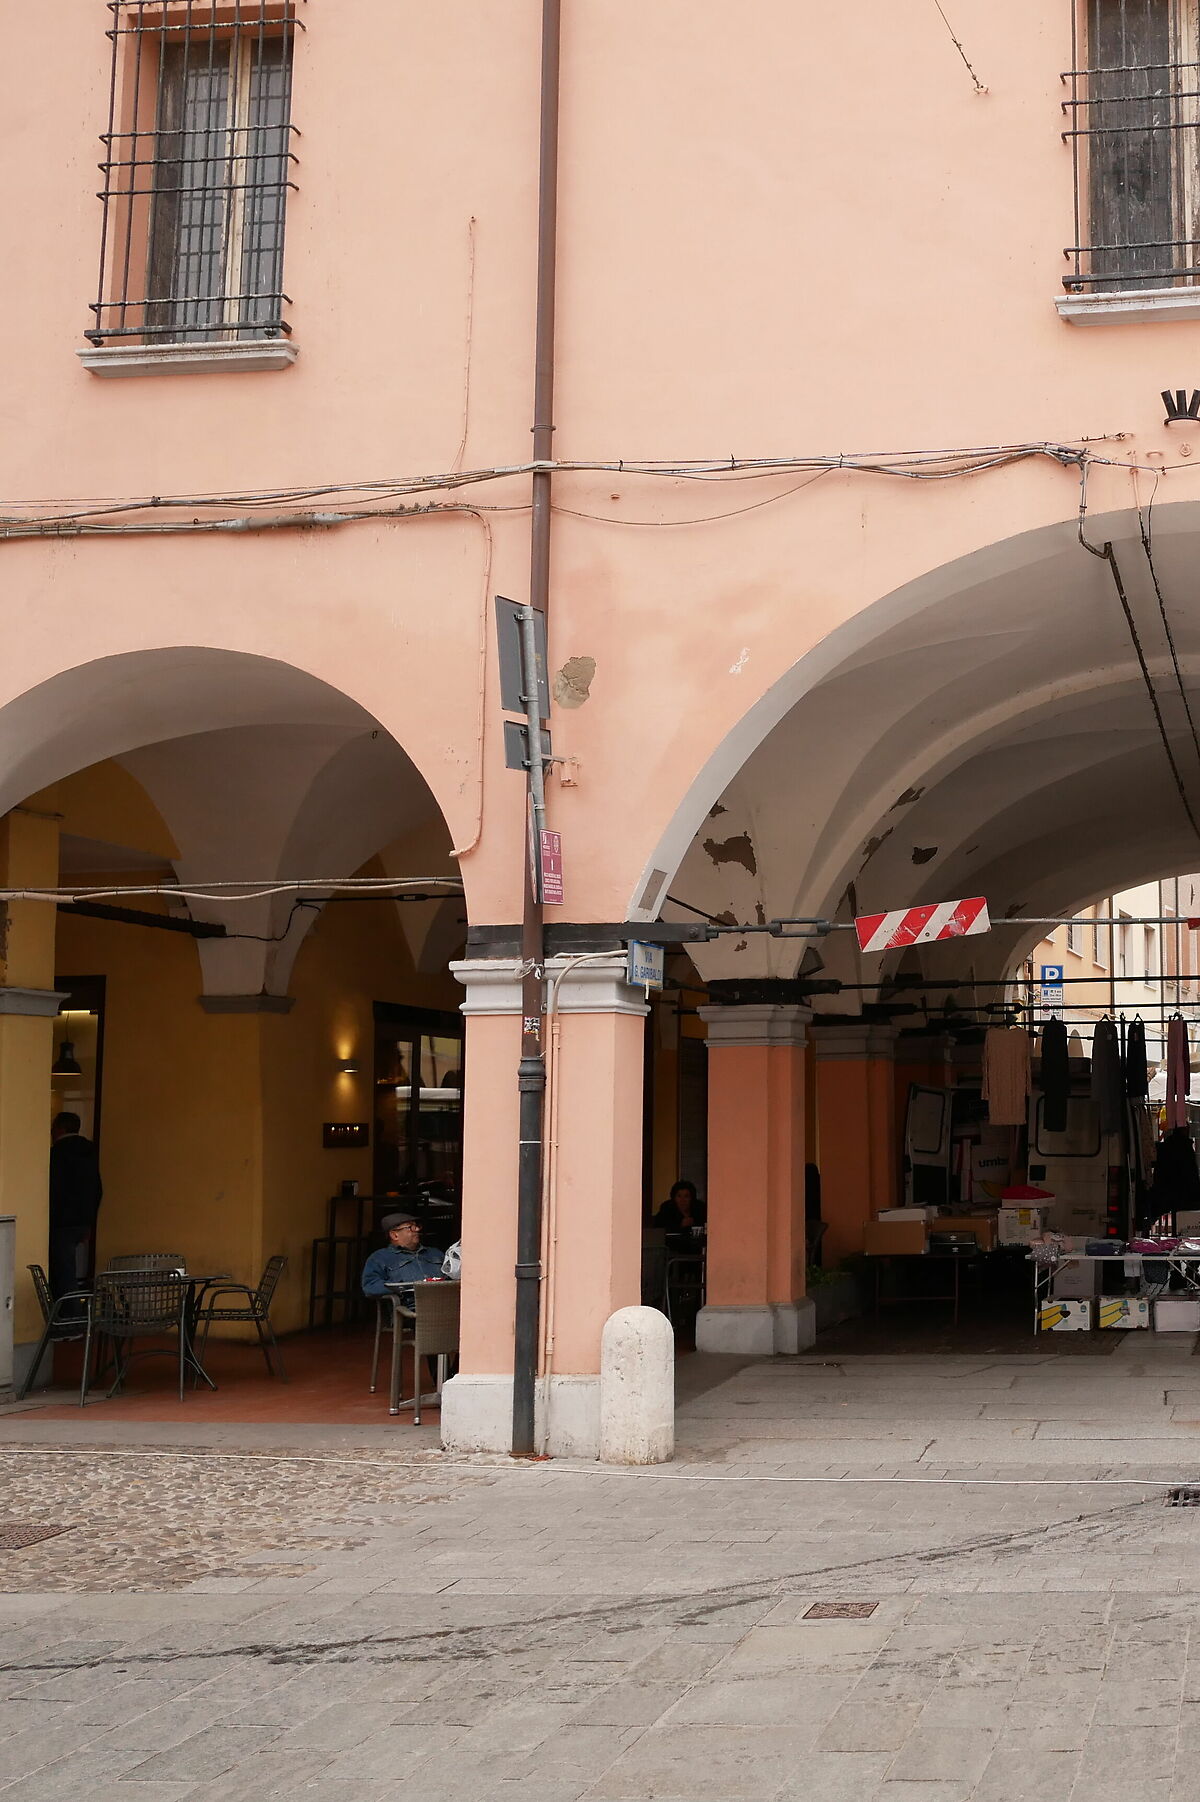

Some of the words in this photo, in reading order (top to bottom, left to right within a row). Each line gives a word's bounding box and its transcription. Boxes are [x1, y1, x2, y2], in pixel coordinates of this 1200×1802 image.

[645, 951, 653, 964] VIA
[640, 965, 662, 981] GARIBALDI
[1045, 967, 1060, 986] P
